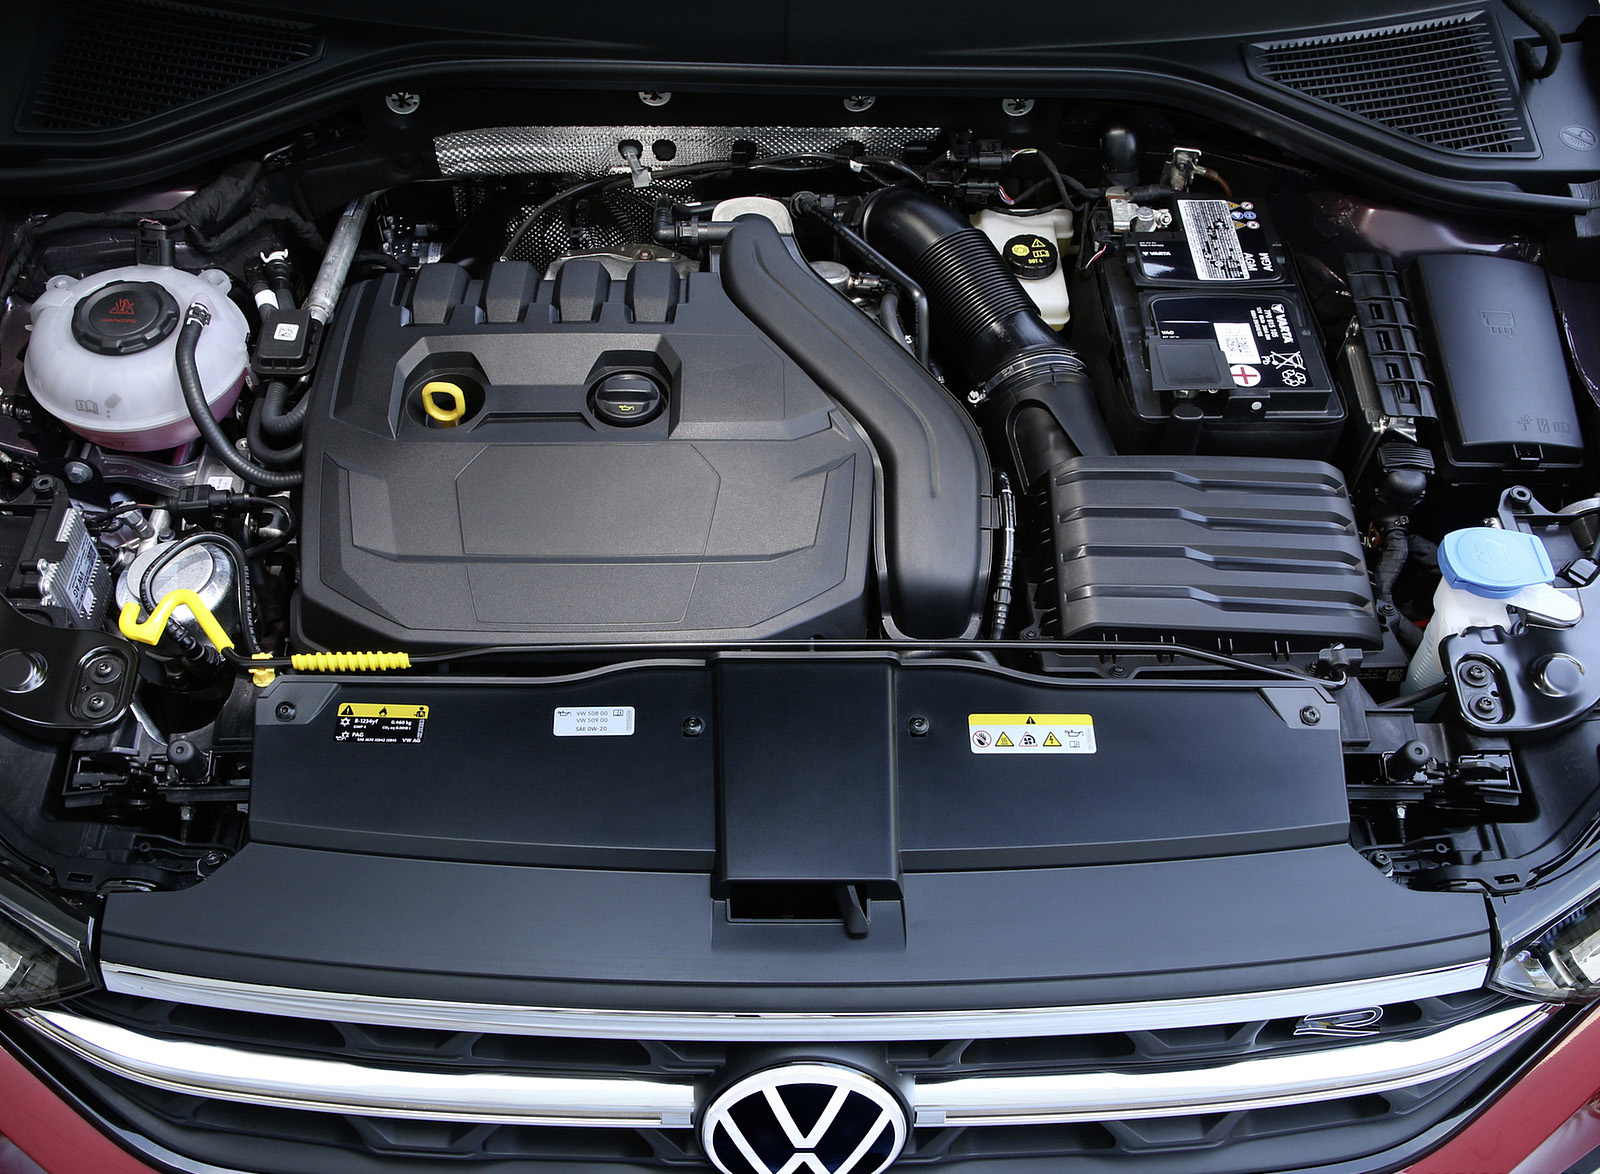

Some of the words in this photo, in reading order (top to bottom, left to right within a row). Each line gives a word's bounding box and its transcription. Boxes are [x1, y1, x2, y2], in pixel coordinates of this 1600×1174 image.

[1243, 252, 1258, 271] AGM
[1258, 252, 1274, 272] AGM
[1276, 314, 1294, 344] VARTA
[1261, 355, 1271, 365] Pb
[76, 571, 85, 586] VW
[73, 583, 80, 598] AG
